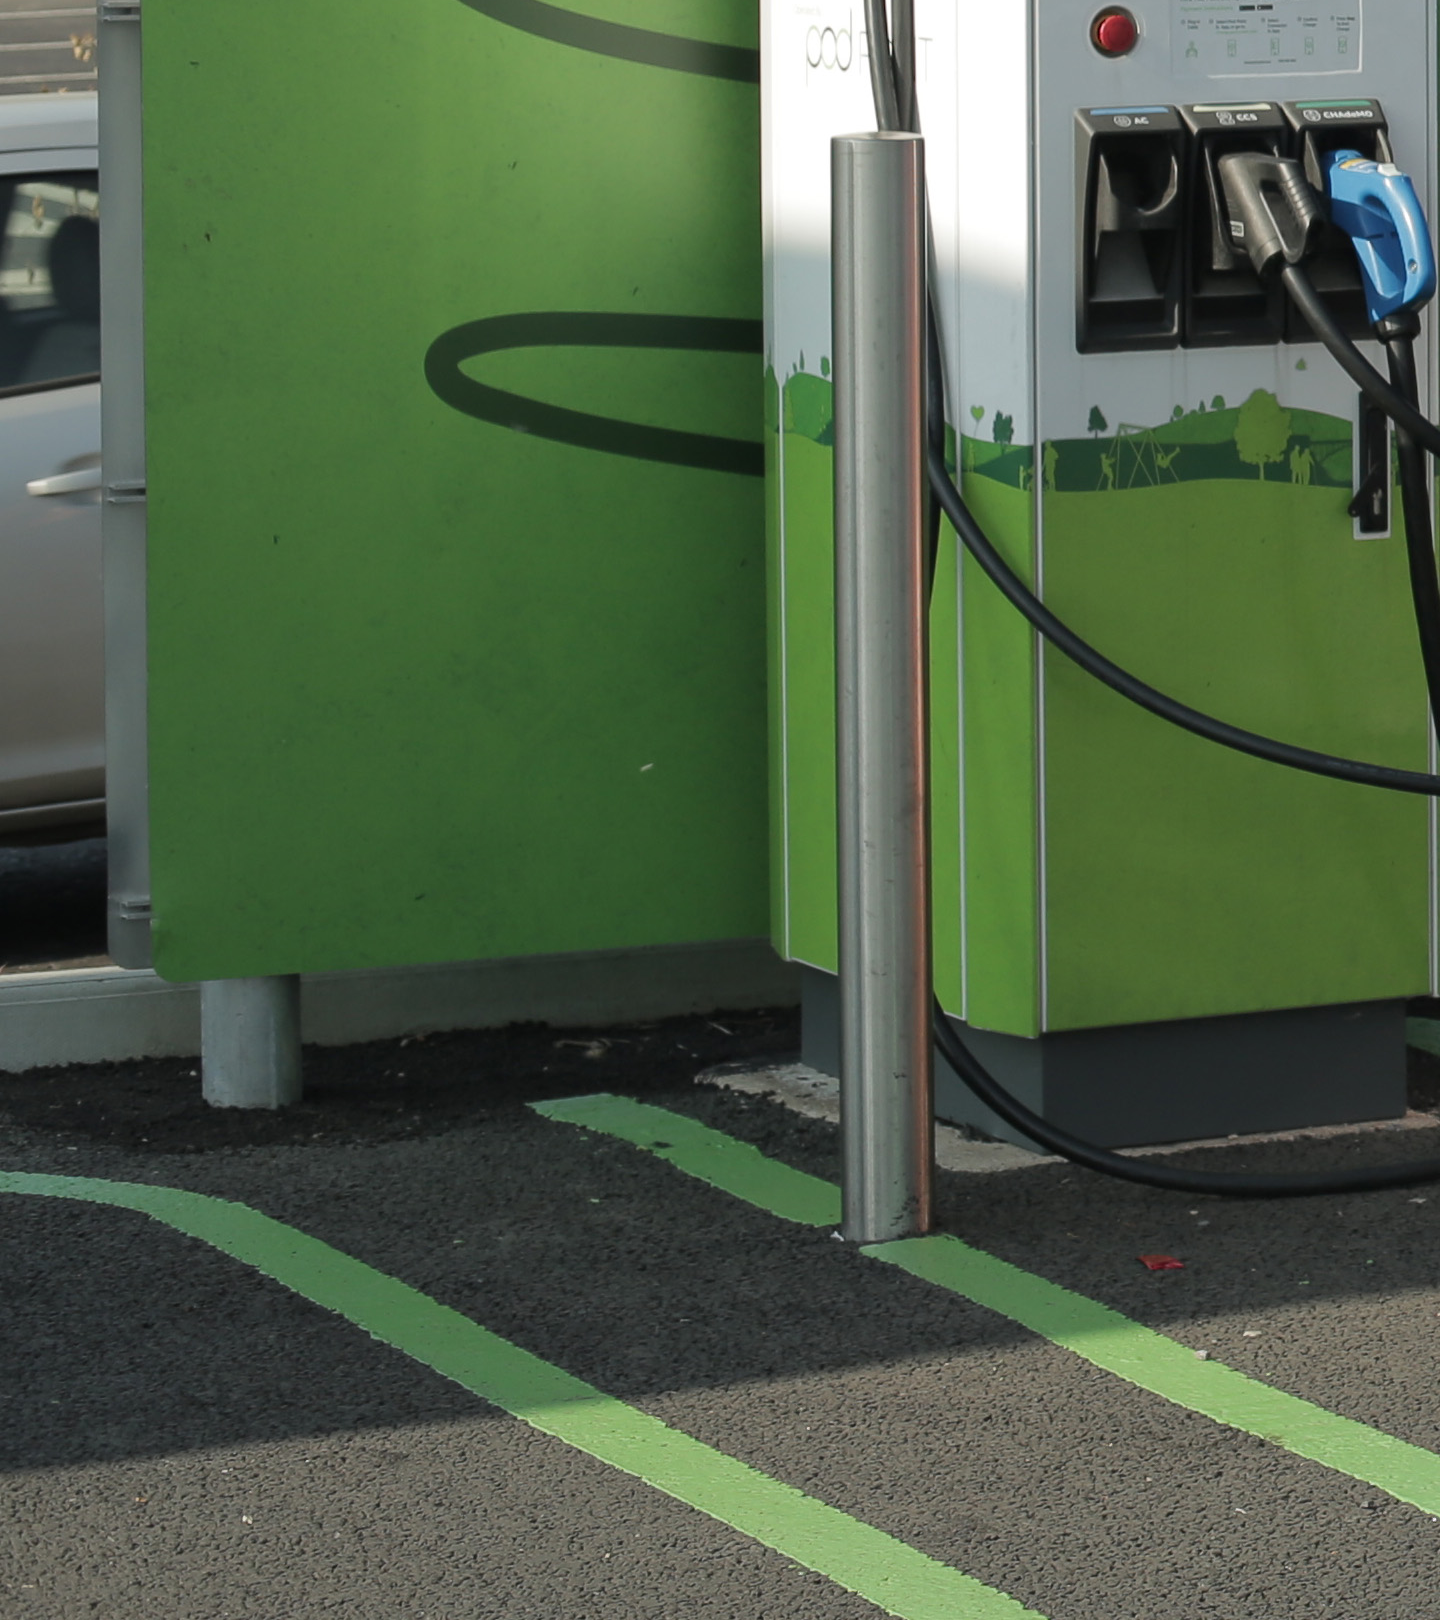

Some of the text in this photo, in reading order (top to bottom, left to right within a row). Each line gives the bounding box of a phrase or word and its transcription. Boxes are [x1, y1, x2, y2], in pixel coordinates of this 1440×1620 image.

[1236, 113, 1258, 122] CCS
[1322, 110, 1374, 120] CHAdeMO
[1134, 117, 1149, 126] AC
